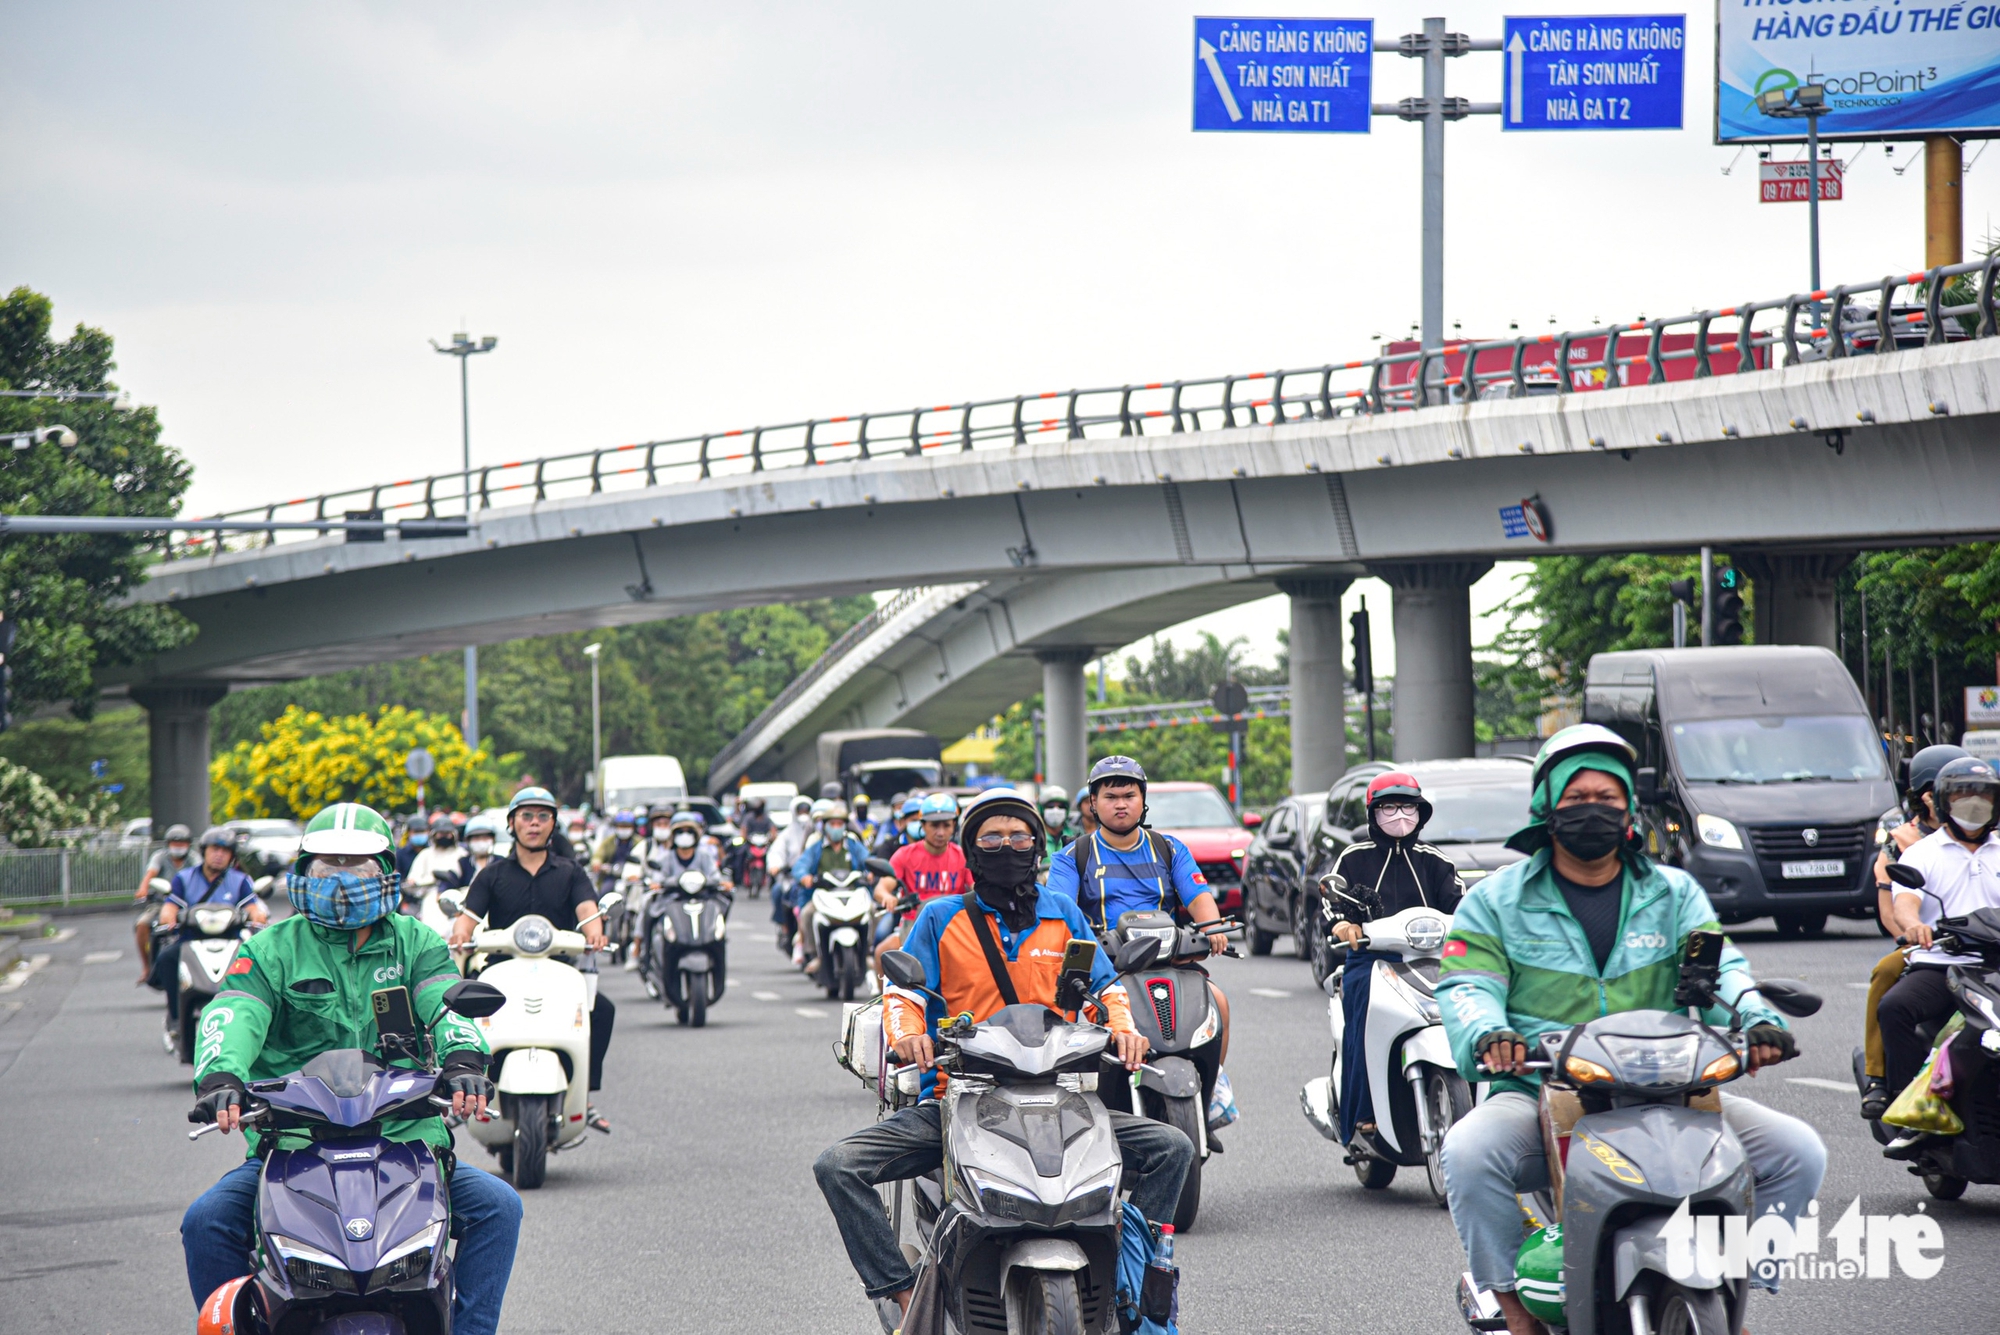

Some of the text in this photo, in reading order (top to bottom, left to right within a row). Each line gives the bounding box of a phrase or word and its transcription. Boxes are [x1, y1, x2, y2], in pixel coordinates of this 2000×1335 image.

[1752, 11, 1835, 40] HÀNG
[1839, 6, 1902, 36] ĐẦU
[1908, 1, 1966, 32] THẾ
[1219, 22, 1368, 53] CẢNG HÀNG KHÔNG
[1529, 21, 1683, 52] CẢNG HÀNG KHÔNG
[1237, 57, 1352, 88] TÂN SƠN NHẤT
[1547, 53, 1661, 86] TÂN SƠN NHẤT
[1251, 93, 1331, 123] NHÀ GA T1
[1546, 91, 1580, 121] NHÀ
[1583, 98, 1605, 121] GA
[1833, 97, 1902, 109] TECHNOLOGY
[1763, 183, 1777, 200] 09
[1779, 182, 1793, 199] 77
[1794, 181, 1807, 198] 44
[1825, 181, 1838, 198] 88
[914, 871, 959, 892] TOMMY
[1626, 931, 1666, 948] Grab
[333, 1151, 372, 1160] HONDA
